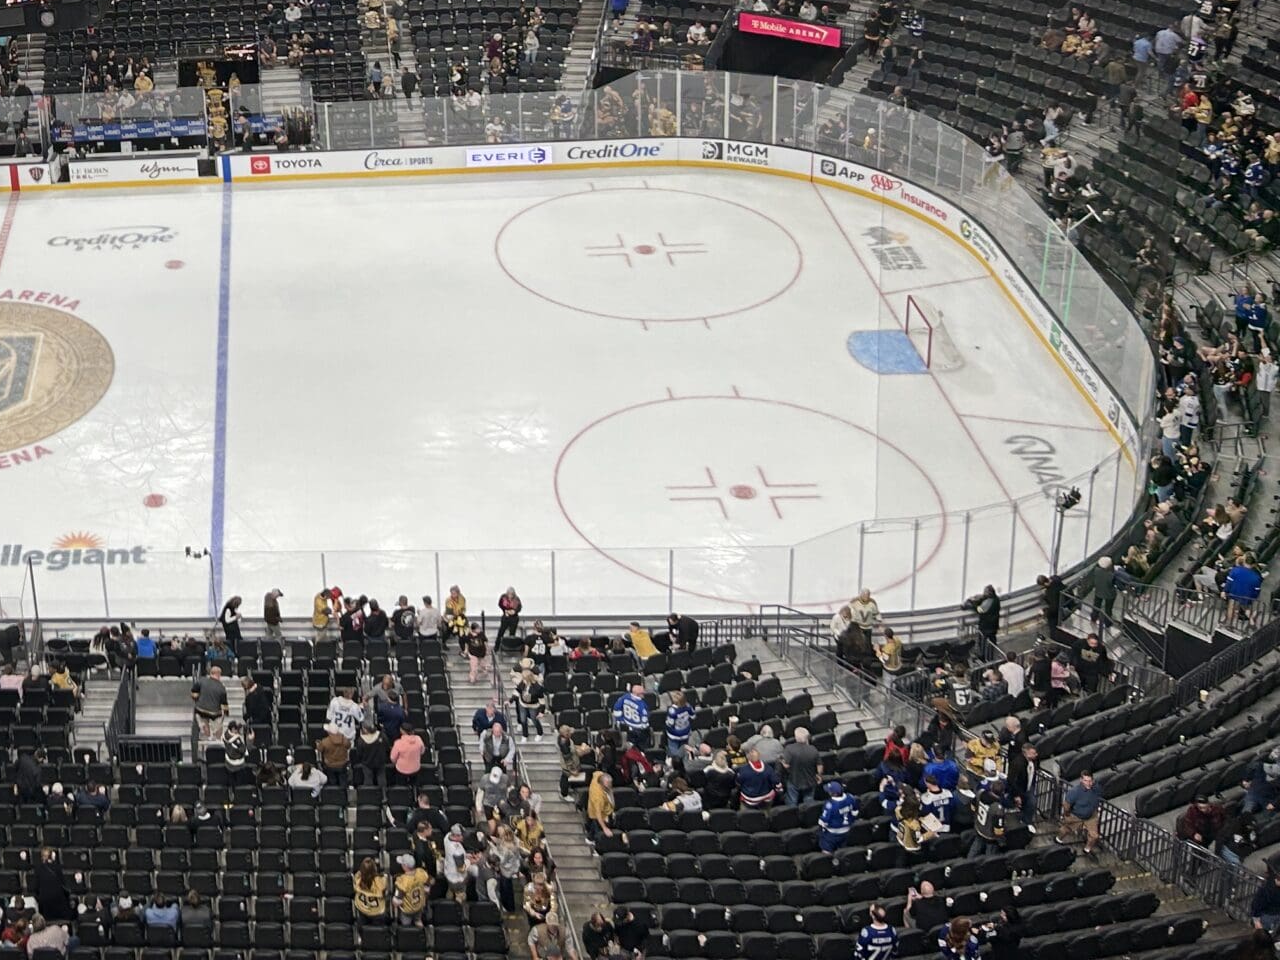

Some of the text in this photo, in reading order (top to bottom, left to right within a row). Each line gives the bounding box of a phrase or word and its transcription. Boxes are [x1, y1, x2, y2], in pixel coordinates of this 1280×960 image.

[788, 28, 821, 38] ARENA
[472, 152, 524, 162] EVERI
[567, 143, 660, 160] CreditOne
[727, 143, 769, 158] MGM
[274, 159, 322, 169] TOYOTA
[364, 152, 433, 170] Circa SPORTS
[727, 155, 770, 166] REWARDS
[47, 231, 175, 247] CreditOne
[0, 289, 81, 311] ARENA
[531, 644, 546, 655] 48
[955, 690, 973, 706] 67
[334, 712, 352, 728] 24
[624, 703, 641, 722] 86
[977, 806, 987, 826] 9
[410, 890, 421, 907] 9
[867, 945, 893, 960] 77
